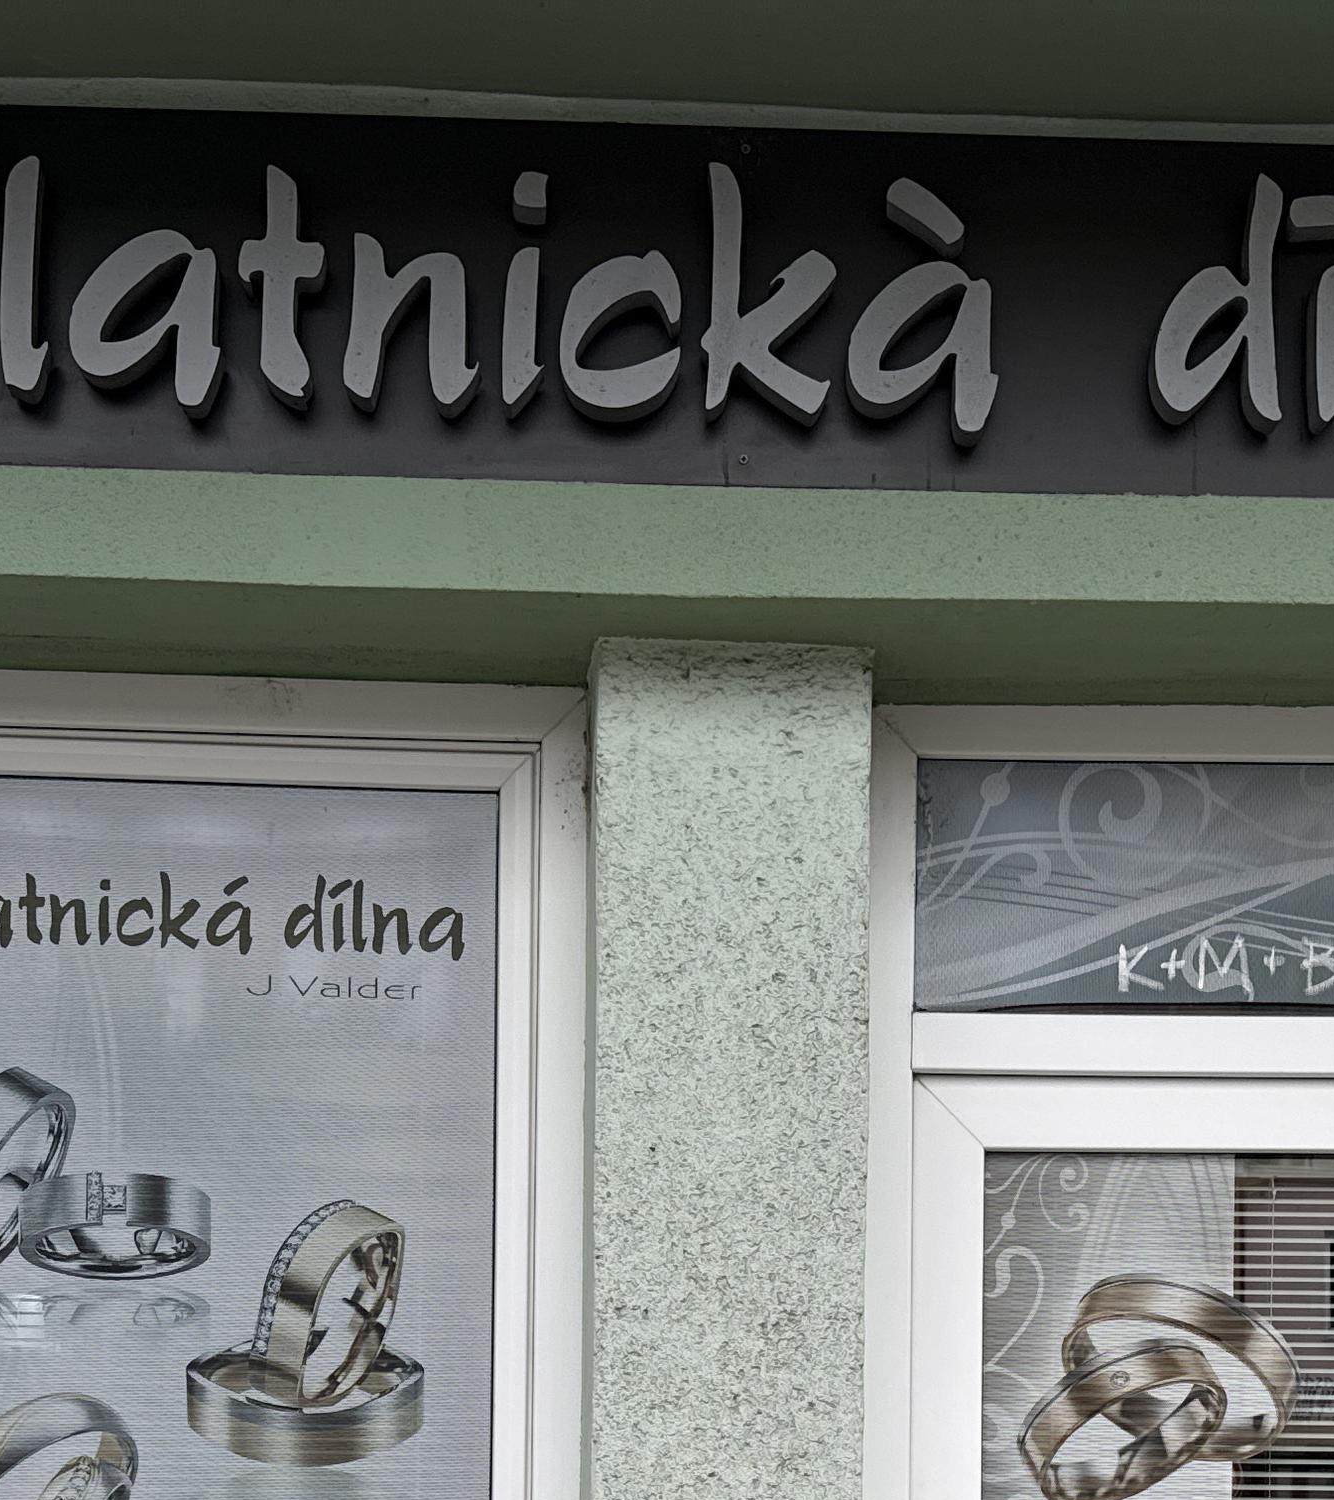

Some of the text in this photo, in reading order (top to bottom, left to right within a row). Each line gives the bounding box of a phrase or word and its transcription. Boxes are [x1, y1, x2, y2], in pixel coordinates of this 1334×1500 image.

[283, 873, 466, 962] dílna
[246, 974, 423, 1001] J Valder
